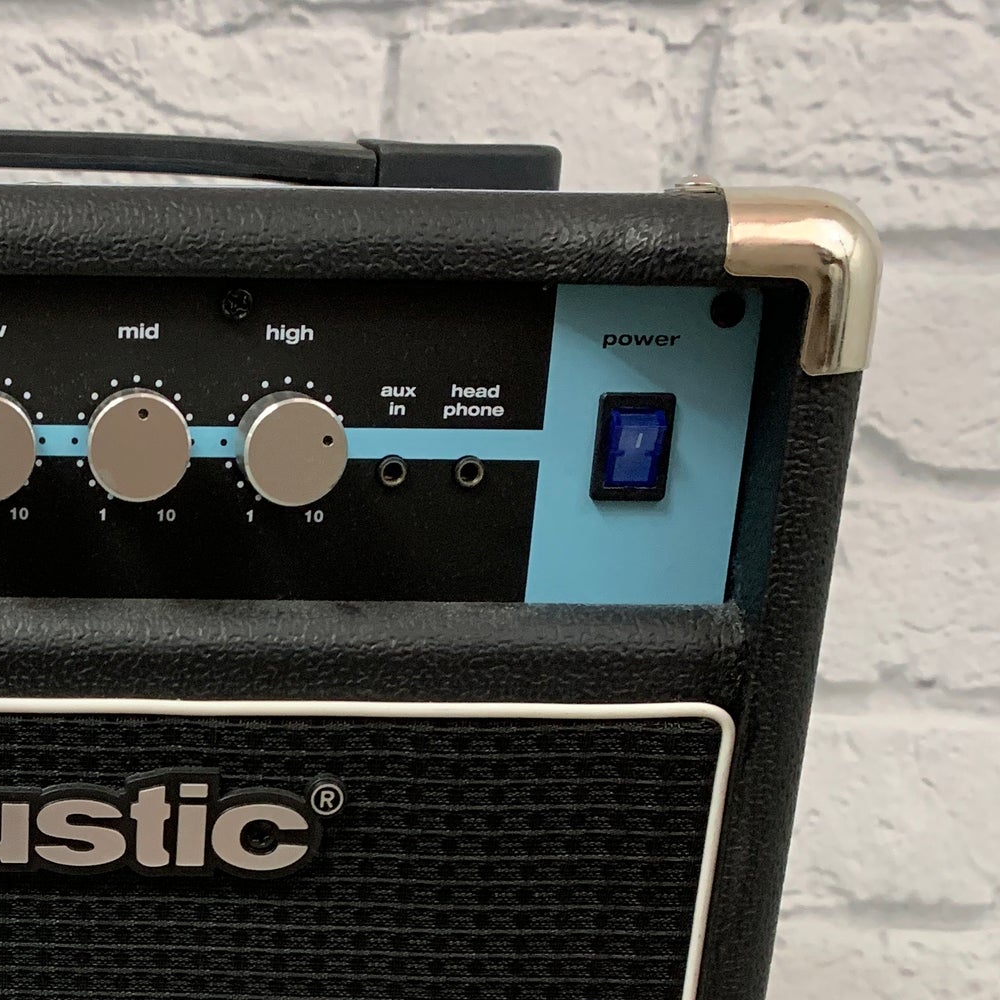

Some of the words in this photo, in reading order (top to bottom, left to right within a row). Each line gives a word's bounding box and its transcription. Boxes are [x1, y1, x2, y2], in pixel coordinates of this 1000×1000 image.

[117, 322, 160, 340] mid
[265, 324, 314, 345] high
[602, 333, 682, 349] power
[380, 385, 417, 398] aux
[451, 383, 501, 399] head
[388, 401, 406, 416] in
[442, 402, 505, 420] phone
[9, 507, 29, 521] 10
[99, 507, 106, 521] 1
[157, 508, 176, 522] 10
[246, 509, 254, 523] 1
[304, 509, 324, 523] 10
